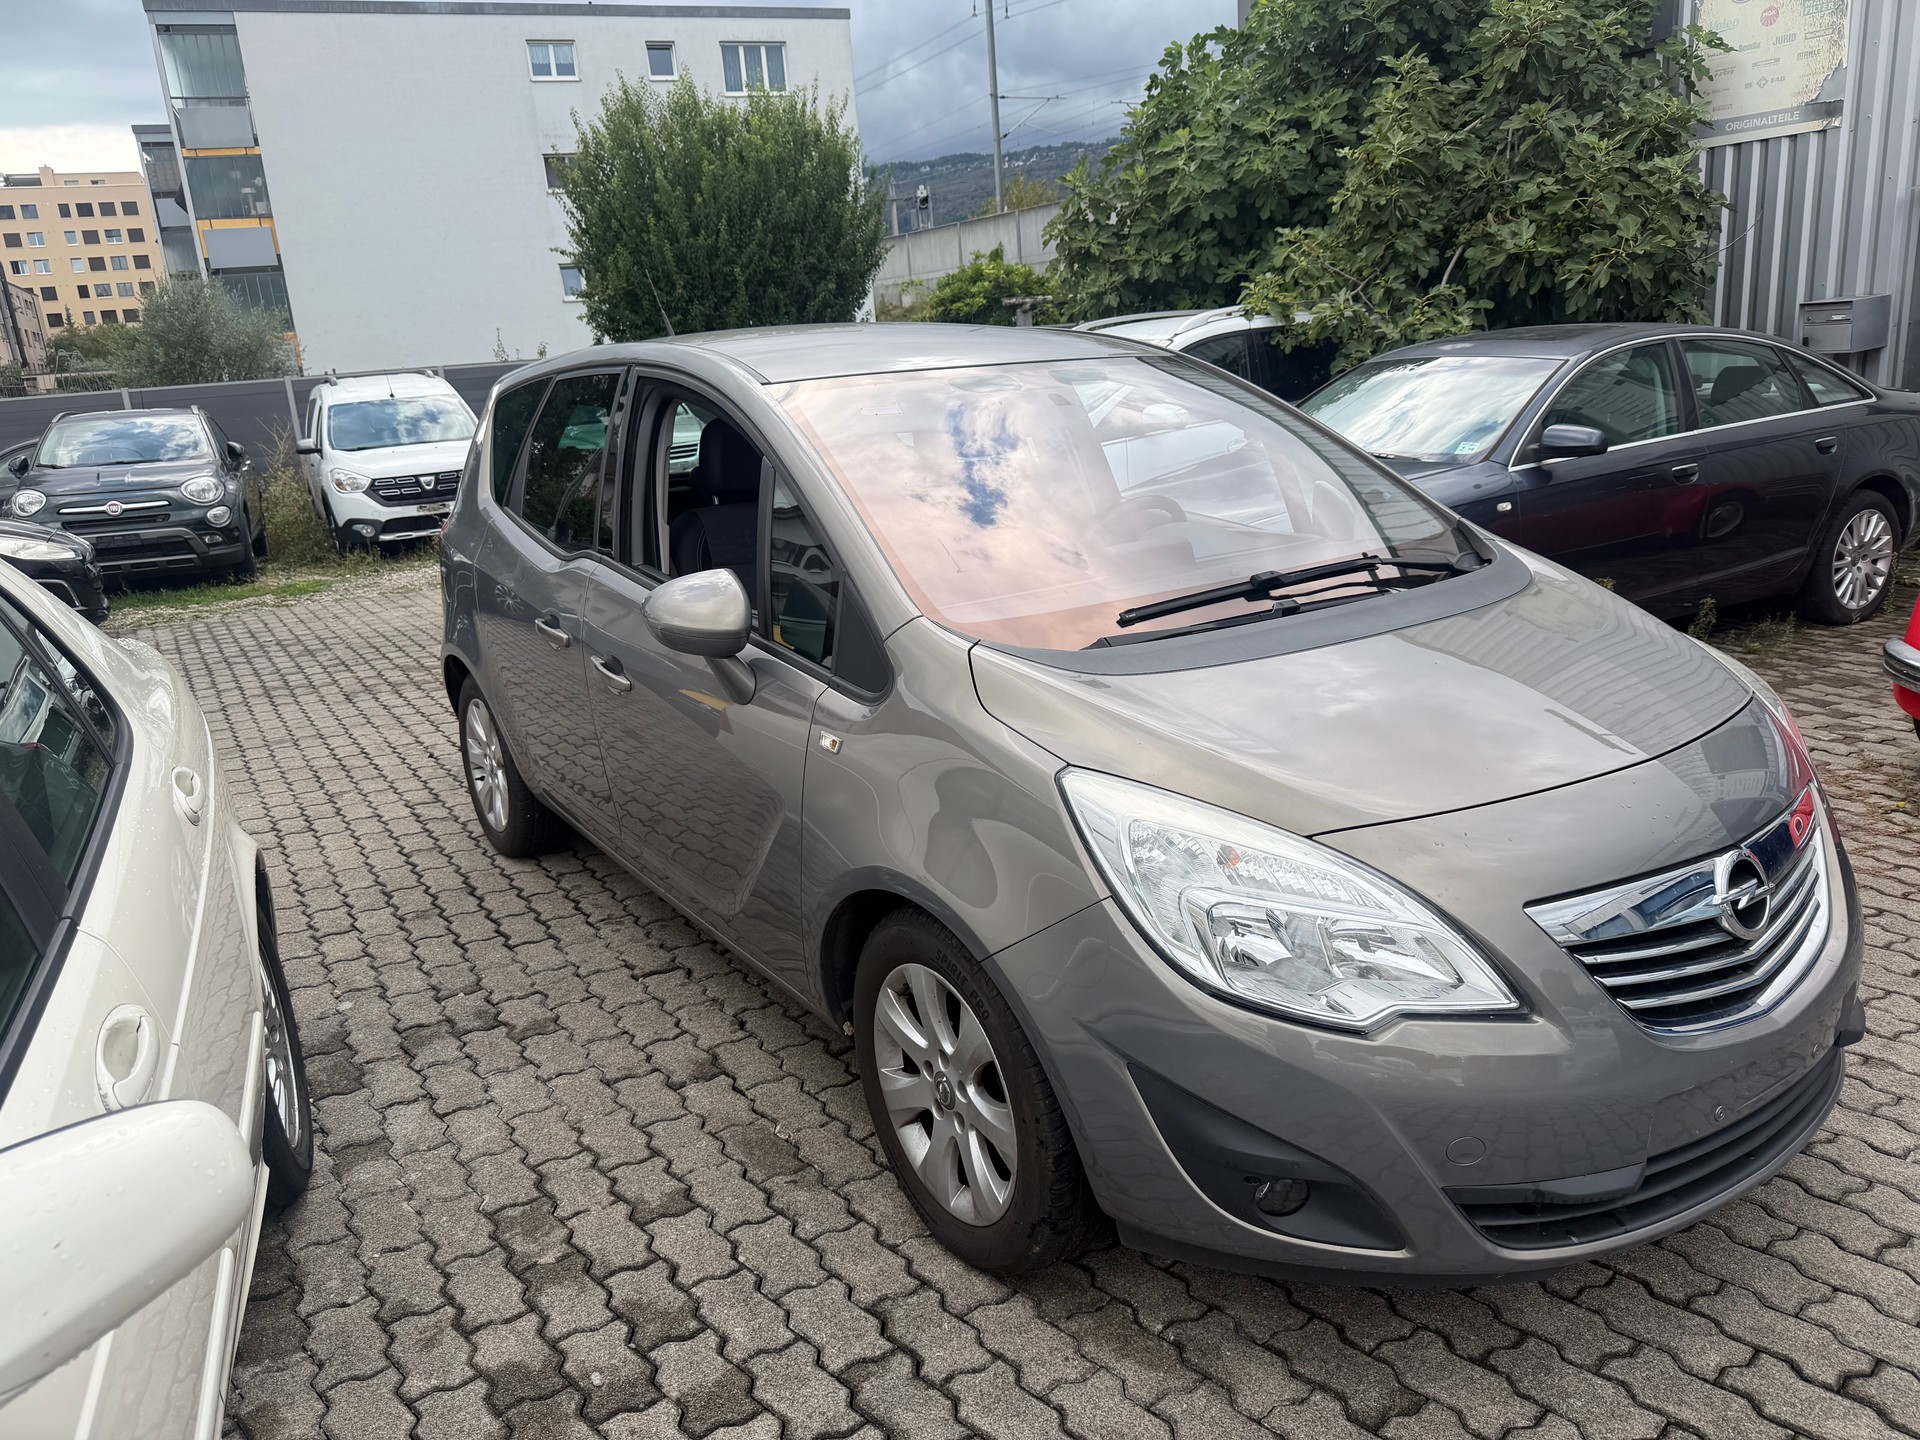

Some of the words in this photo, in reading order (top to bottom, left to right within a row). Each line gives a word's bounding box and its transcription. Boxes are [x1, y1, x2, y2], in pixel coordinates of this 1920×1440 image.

[1804, 3, 1835, 15] FILTER
[1772, 32, 1797, 46] JURID
[1725, 110, 1800, 132] ORIGINALTEILE
[935, 948, 969, 987] SPIRIT
[969, 989, 990, 1020] PRO
